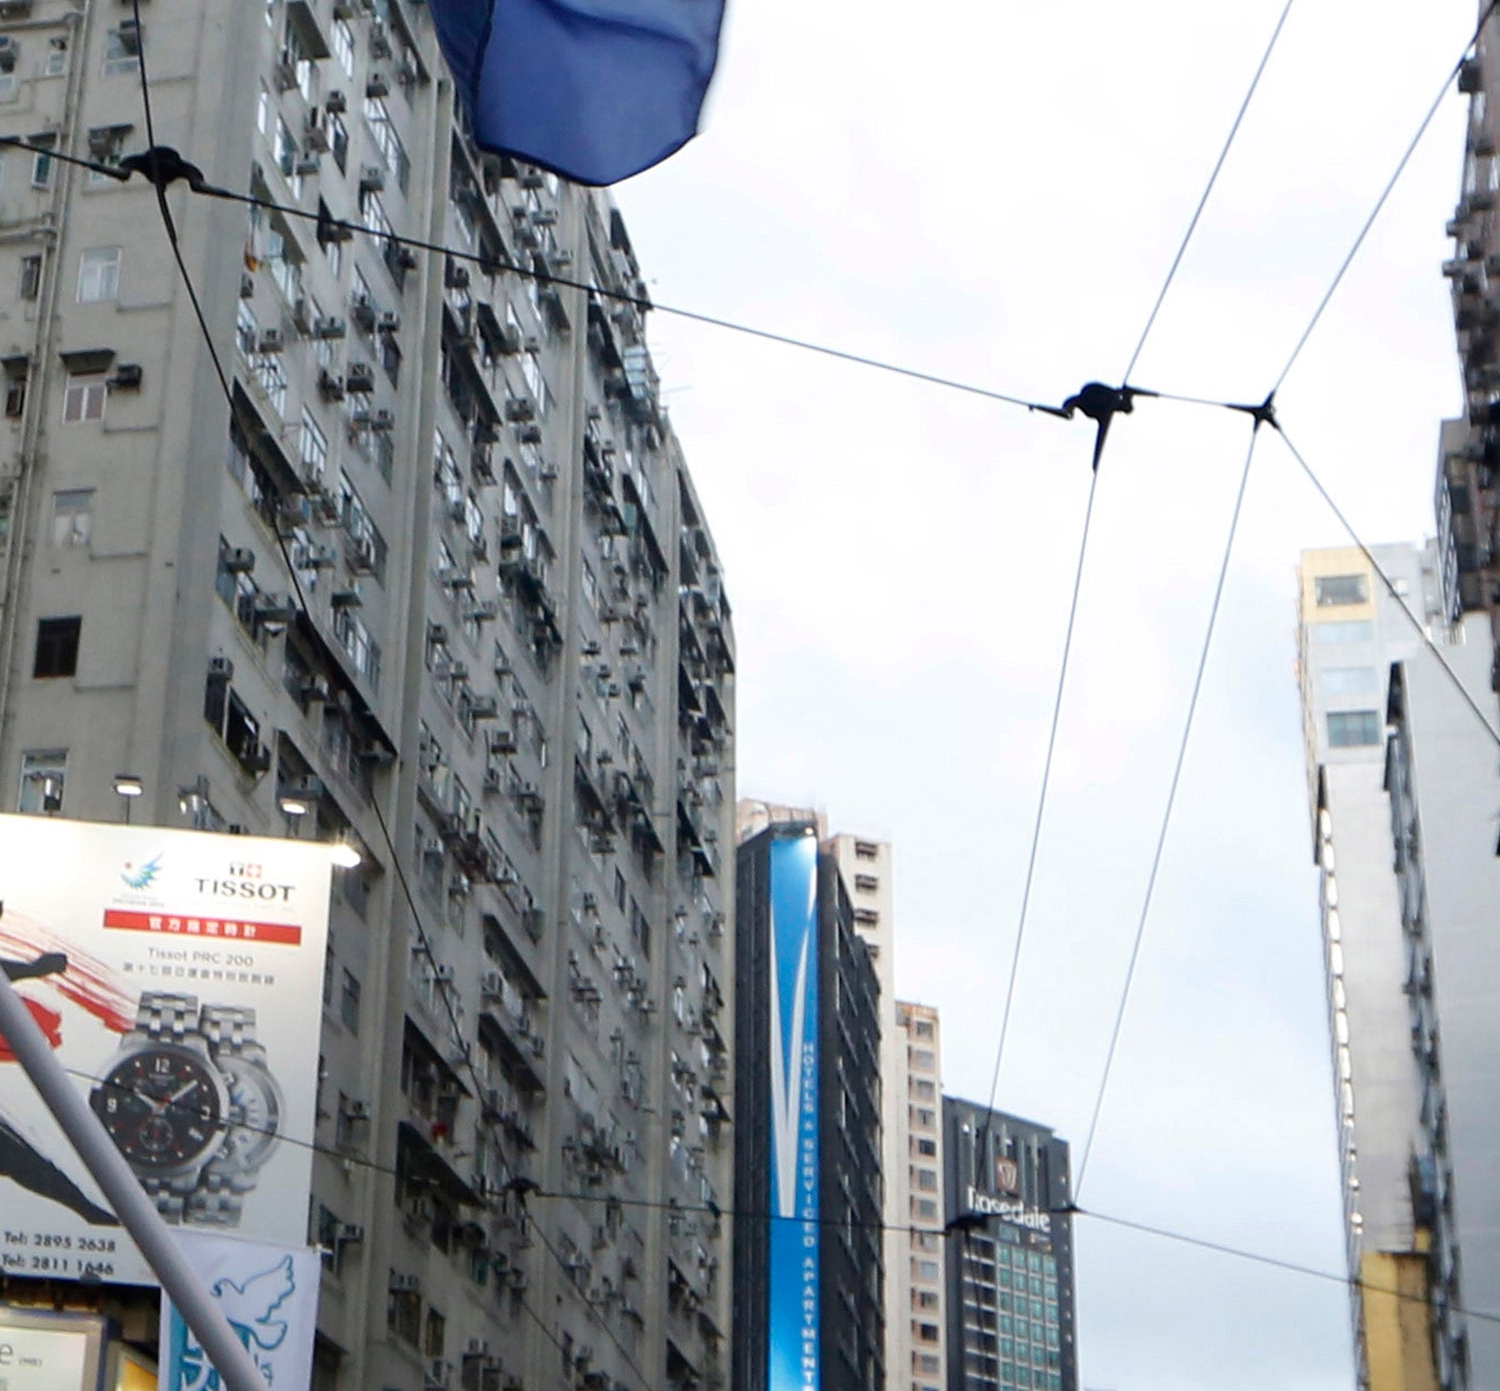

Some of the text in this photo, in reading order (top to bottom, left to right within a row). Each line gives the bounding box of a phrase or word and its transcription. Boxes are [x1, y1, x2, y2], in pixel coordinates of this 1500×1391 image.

[194, 877, 296, 903] TISSOT
[147, 946, 254, 968] Tissot PRC 200
[802, 1043, 814, 1112] HOTELS
[803, 1137, 814, 1248] SERVICED
[967, 1185, 1052, 1232] Rosedale
[34, 1232, 73, 1251] 2895
[78, 1236, 117, 1255] 2638
[31, 1255, 70, 1275] 2811
